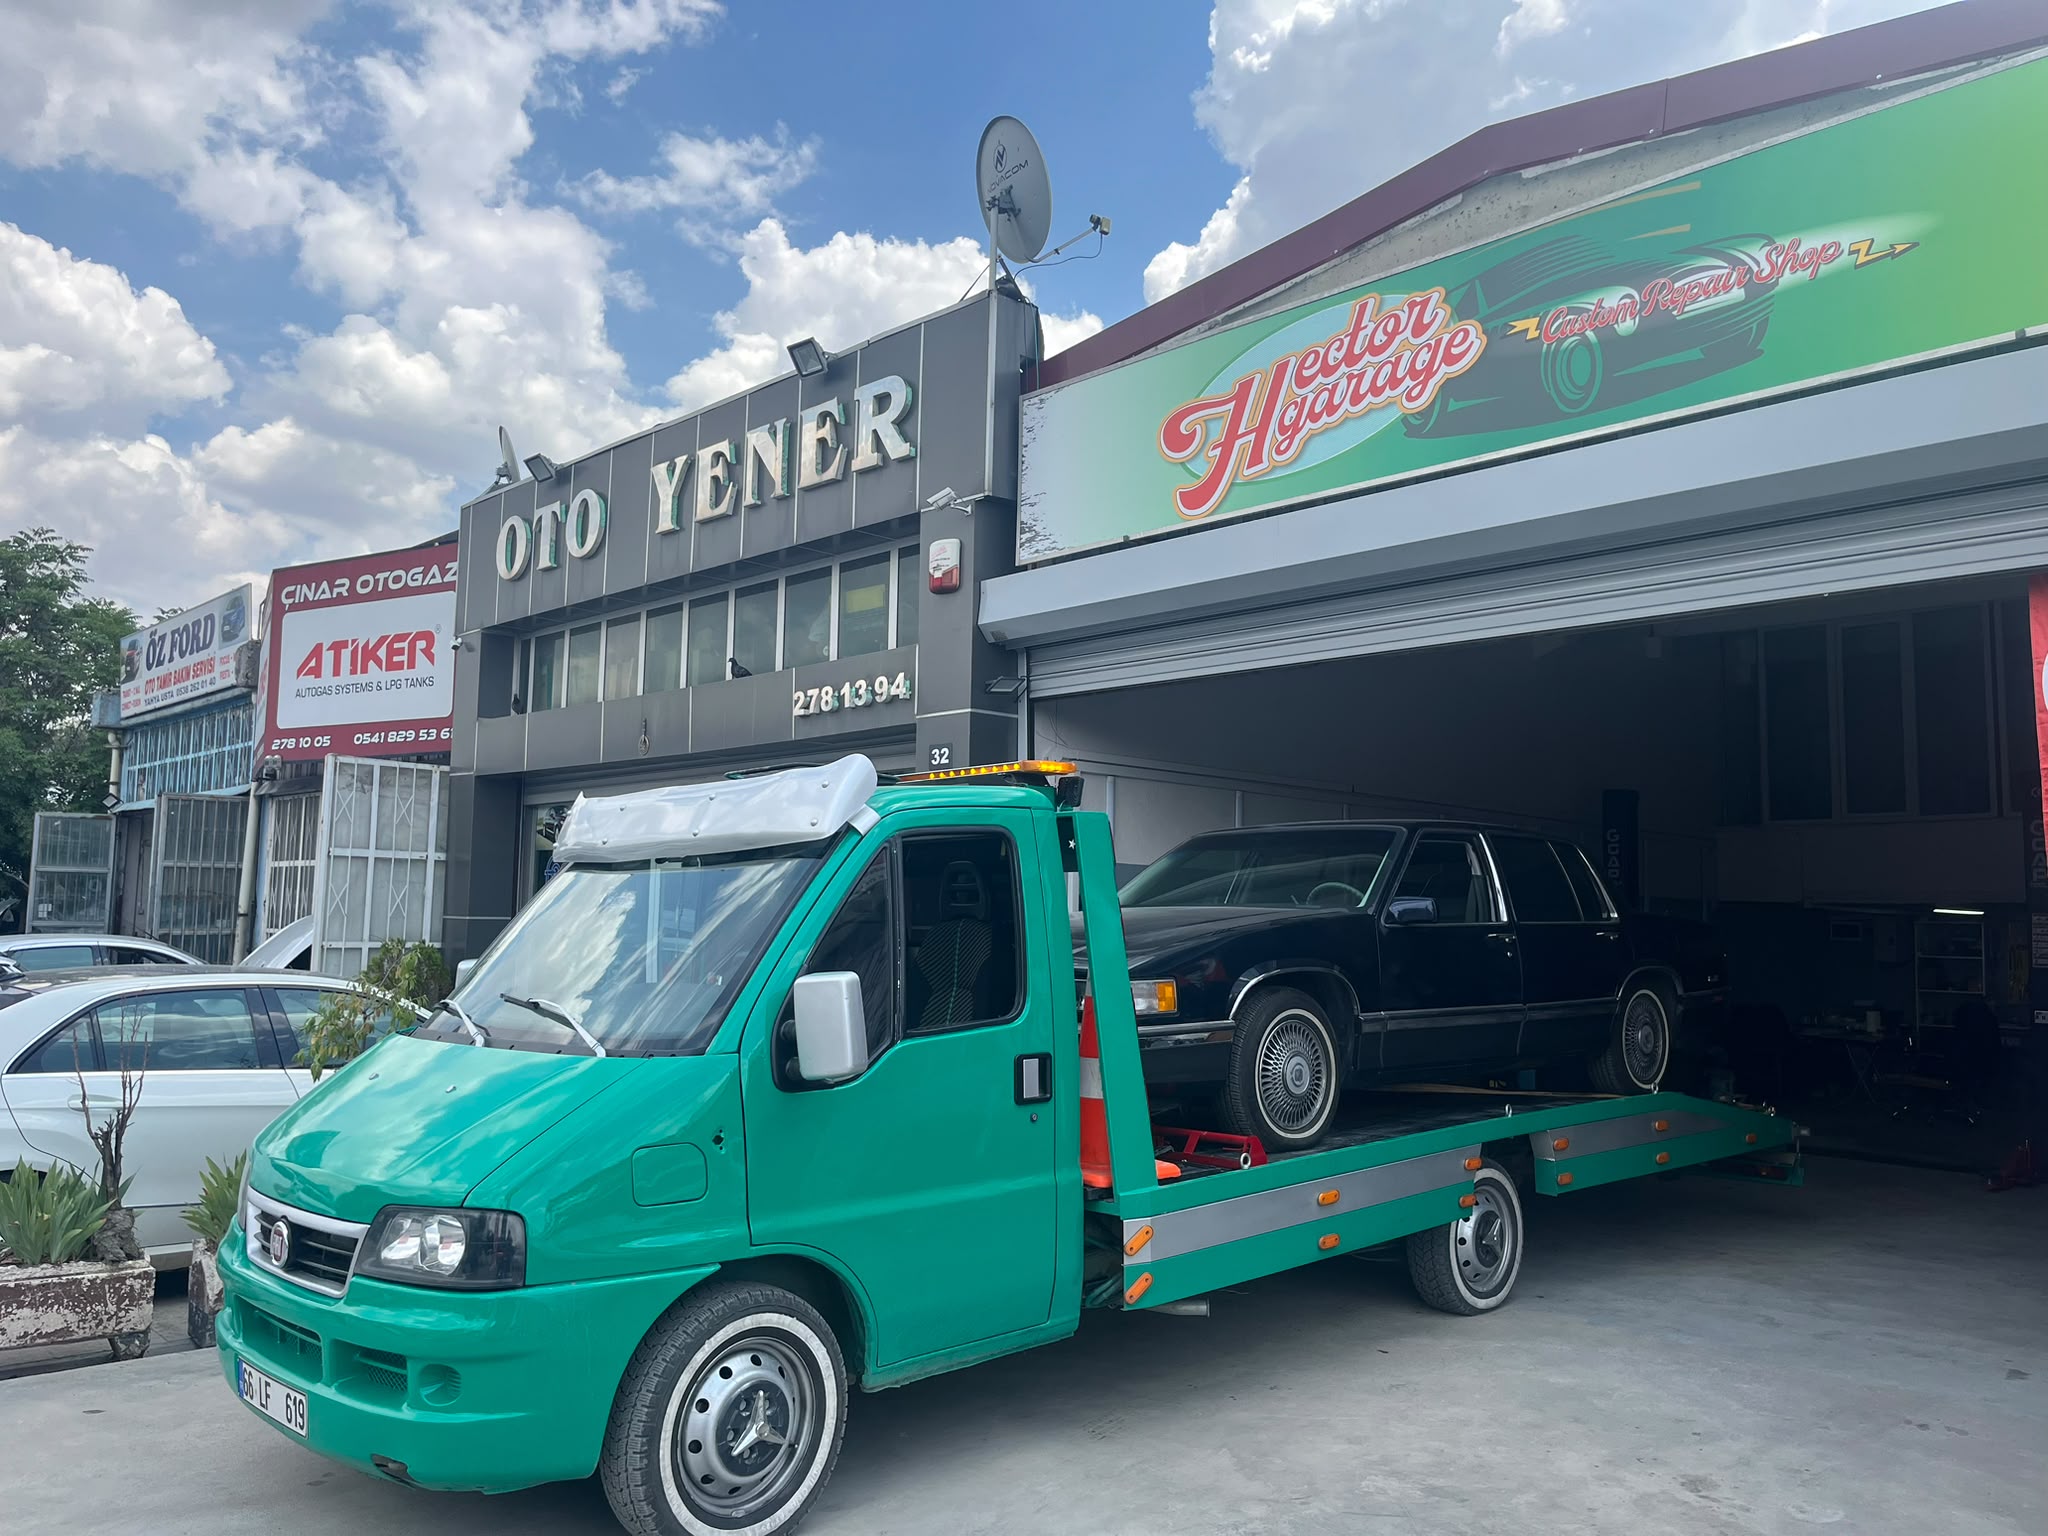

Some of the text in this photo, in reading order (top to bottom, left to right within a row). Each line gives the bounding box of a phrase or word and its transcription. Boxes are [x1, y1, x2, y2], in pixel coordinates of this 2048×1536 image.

[1542, 237, 1843, 344] Custom Repair Shop
[1159, 290, 1449, 516] Hector
[1273, 323, 1482, 462] garage
[496, 374, 917, 582] OTO YENER
[281, 561, 458, 611] ÇINAR OTOGAZ
[145, 613, 215, 672] ÖZ FORD
[144, 677, 156, 696] OTO
[160, 690, 174, 702] USTA
[295, 676, 435, 699] AUTOGAS SYSTEMS & LPG TANKS
[793, 672, 909, 716] 278 13 94
[271, 735, 331, 750] 278 10 05
[353, 732, 385, 745] 0541
[387, 729, 415, 743] 829
[418, 728, 437, 741] 53
[931, 747, 950, 765] 32
[242, 1366, 305, 1431] 66 LF 619
